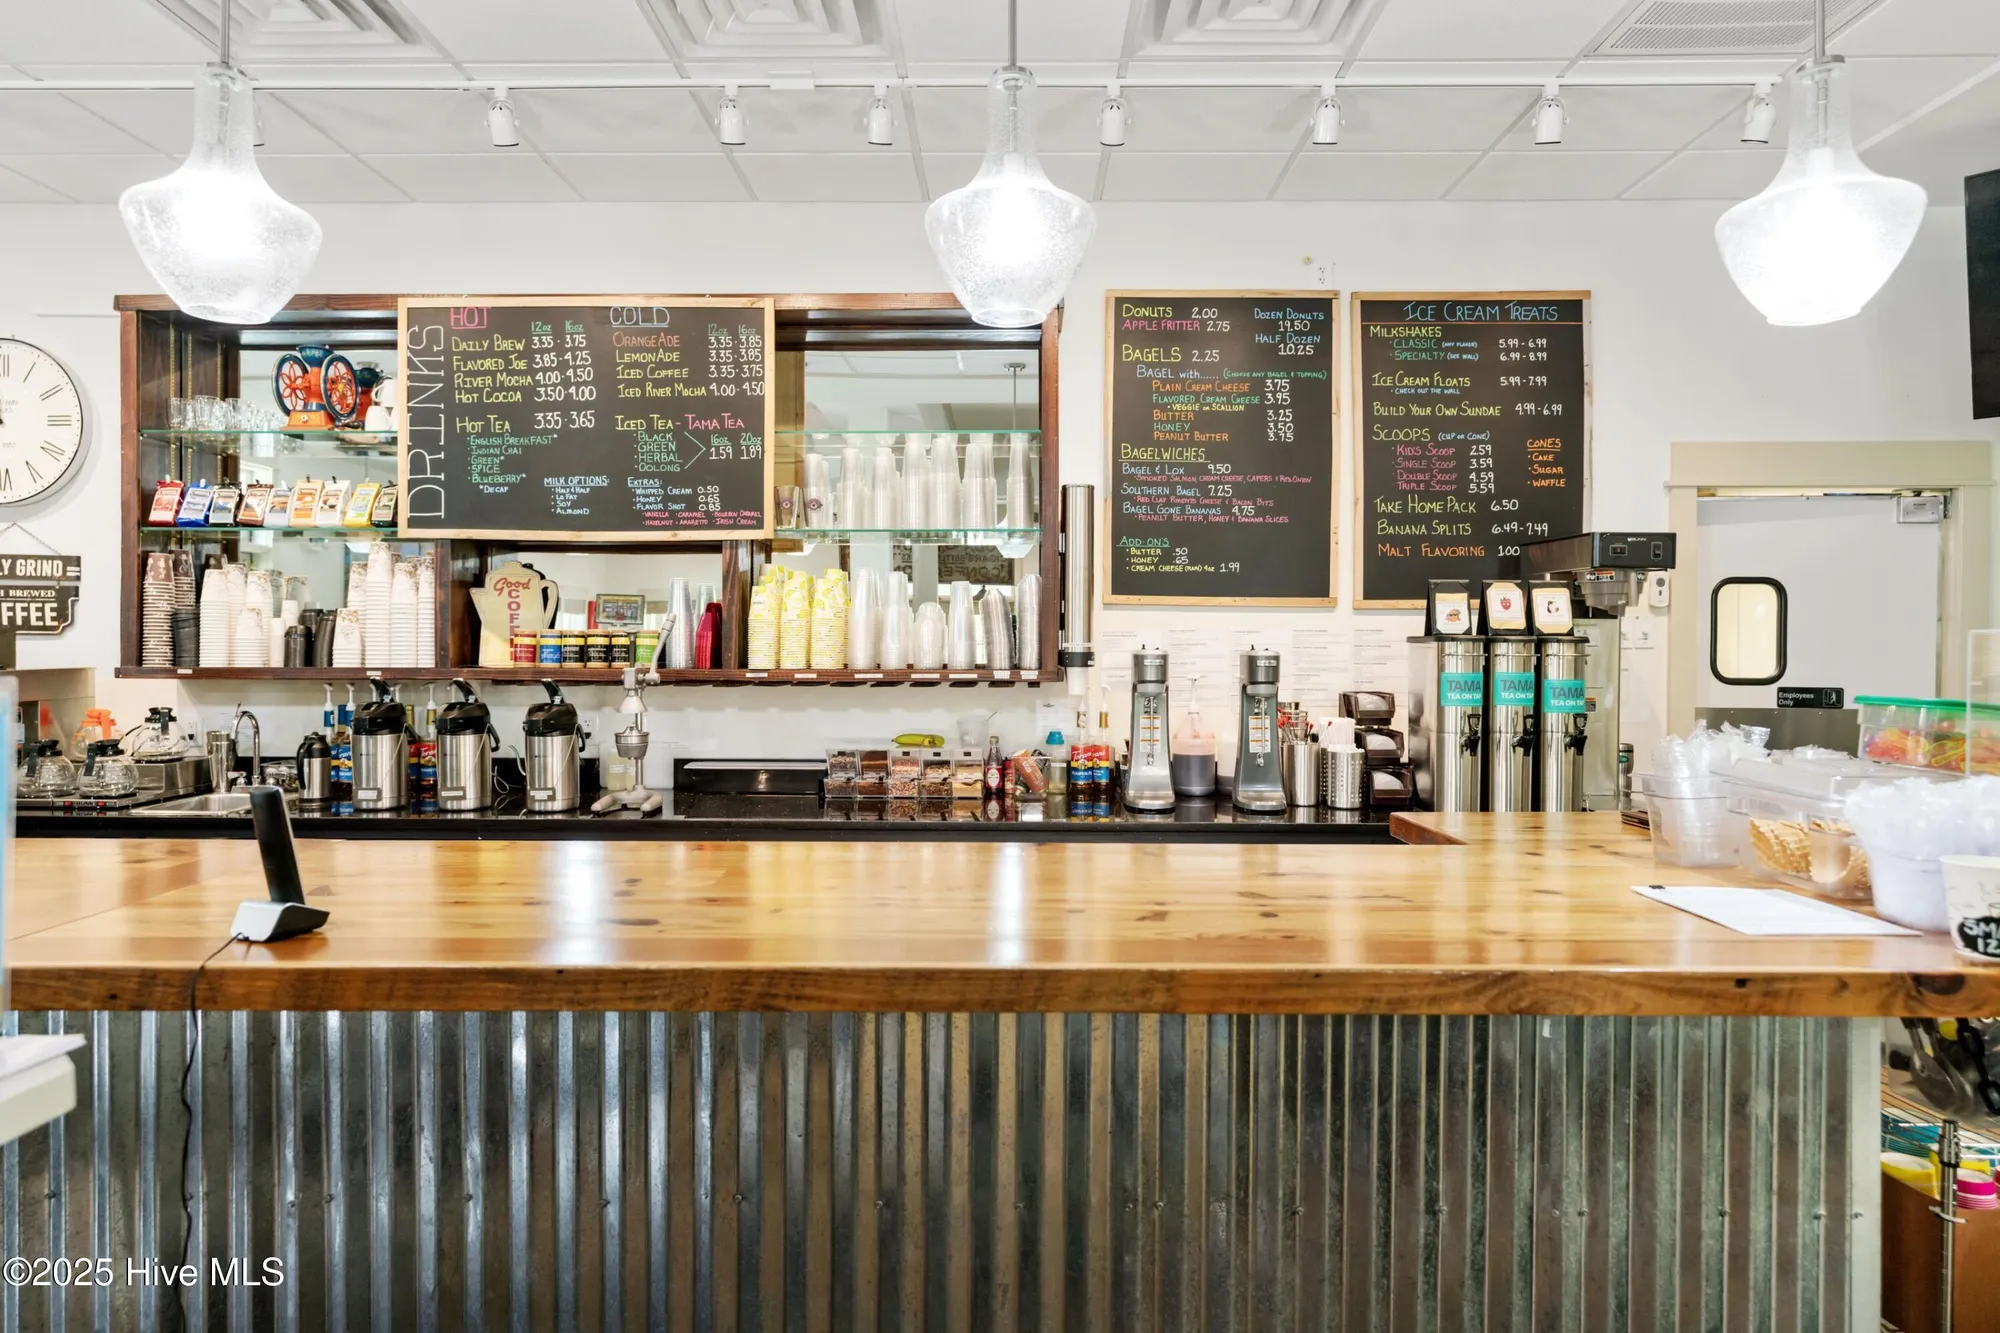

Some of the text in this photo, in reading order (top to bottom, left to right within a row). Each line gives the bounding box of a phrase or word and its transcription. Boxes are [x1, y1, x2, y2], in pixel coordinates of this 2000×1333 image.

[451, 307, 491, 327] HOT
[610, 306, 670, 325] COLD
[1123, 304, 1218, 319] DONUTS 2.00
[1255, 308, 1324, 320] DOZEN DONUTS
[1403, 301, 1558, 321] ICE CREAM TREATS
[1122, 320, 1230, 331] APPLE FRITTER 2.75
[1370, 326, 1441, 337] MILKSHAKES
[452, 337, 489, 351] DAILY
[494, 334, 525, 350] BREW
[1256, 334, 1320, 344] HALF DOZEN
[1122, 345, 1220, 362] BAGELS 2.25
[1395, 350, 1445, 360] SPECIALTY
[453, 356, 504, 370] FLAVORED
[509, 354, 527, 369] JOE
[454, 368, 593, 387] RIVER MOCHA 4.00 4.50
[1372, 372, 1393, 386] ICE
[1395, 371, 1429, 386] CREAM
[1434, 372, 1470, 386] FLOATS
[1152, 381, 1182, 392] PLAIN
[1215, 379, 1250, 391] CHEESE
[455, 390, 479, 403] HOT
[483, 389, 522, 402] COCOA
[534, 387, 564, 401] 3.50
[1153, 395, 1195, 404] FLAVORED
[1200, 394, 1226, 404] CREAM
[1373, 402, 1405, 416] BUILD
[1409, 404, 1431, 416] YOUR
[1436, 404, 1457, 416] OWN
[1460, 401, 1501, 416] SUNDAE
[407, 324, 444, 519] DRINKS
[615, 415, 646, 430] ICED
[684, 414, 720, 429] TAMA
[721, 413, 745, 429] TEA
[1154, 411, 1194, 420] BUTTER
[456, 416, 484, 434] HOT
[487, 415, 511, 432] TEA
[1154, 423, 1190, 431] HONEY
[638, 432, 673, 441] BLACK
[1194, 432, 1228, 441] BUTTER
[638, 442, 676, 451] GREEN
[1527, 439, 1561, 448] CONES
[638, 452, 683, 462] HERBAL
[1395, 458, 1493, 468] SINGLE SCOOP 3.59
[1533, 453, 1554, 461] CAKE
[472, 465, 500, 473] SPICE
[639, 463, 680, 472] OOLONG
[1532, 465, 1563, 474] SUGAR
[1397, 470, 1431, 480] DOUBLE
[1433, 472, 1457, 481] SCOOP
[1397, 482, 1425, 490] TRIPLE
[1430, 482, 1457, 491] SCOOP
[1533, 479, 1566, 487] WAFFLE
[1121, 483, 1169, 495] SOUTHERN
[1176, 486, 1200, 496] BAGEL
[1123, 502, 1154, 514] BAGEL
[1157, 504, 1181, 514] GONE
[1374, 496, 1402, 514] TAKE
[1408, 495, 1444, 514] HOME
[1447, 497, 1476, 514] PACK
[1377, 519, 1427, 535] BANANA
[1432, 520, 1471, 535] SPLITS
[16, 559, 63, 576] GRIND
[493, 577, 531, 596] Good
[1447, 680, 1481, 692] TAMA
[1500, 680, 1533, 691] TAMA
[1550, 687, 1584, 698] TAMA
